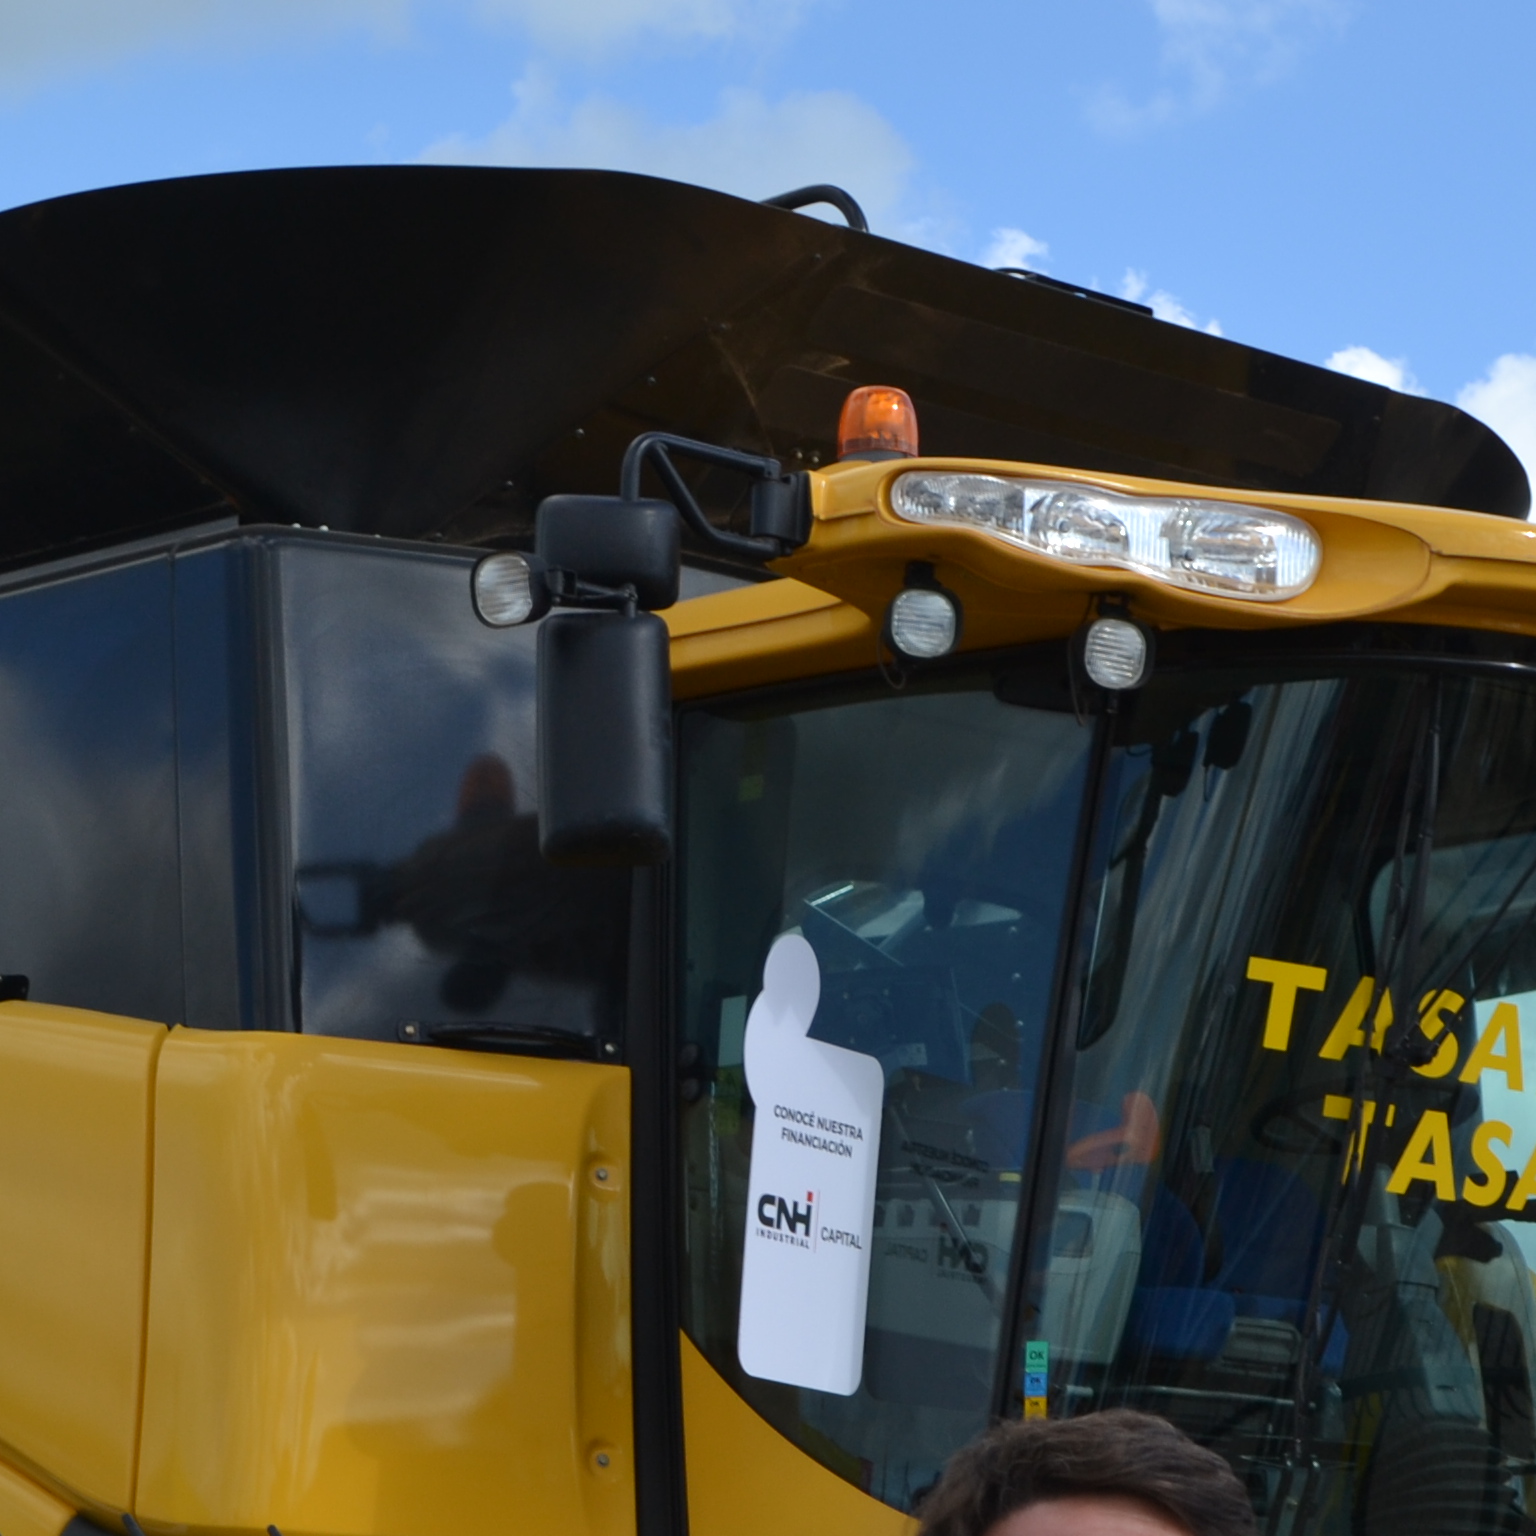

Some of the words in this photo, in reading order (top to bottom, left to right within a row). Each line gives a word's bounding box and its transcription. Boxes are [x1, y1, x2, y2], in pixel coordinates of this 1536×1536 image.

[1246, 956, 1524, 1093] TASA
[773, 1103, 815, 1127] CONOCÉ
[816, 1116, 864, 1141] NUESTRA
[781, 1126, 853, 1158] FINANCIACIÓN
[757, 1192, 813, 1238] CNH
[755, 1227, 810, 1249] INDUSTRIAL
[820, 1226, 862, 1250] CAPITAL
[1029, 1350, 1044, 1360] OK
